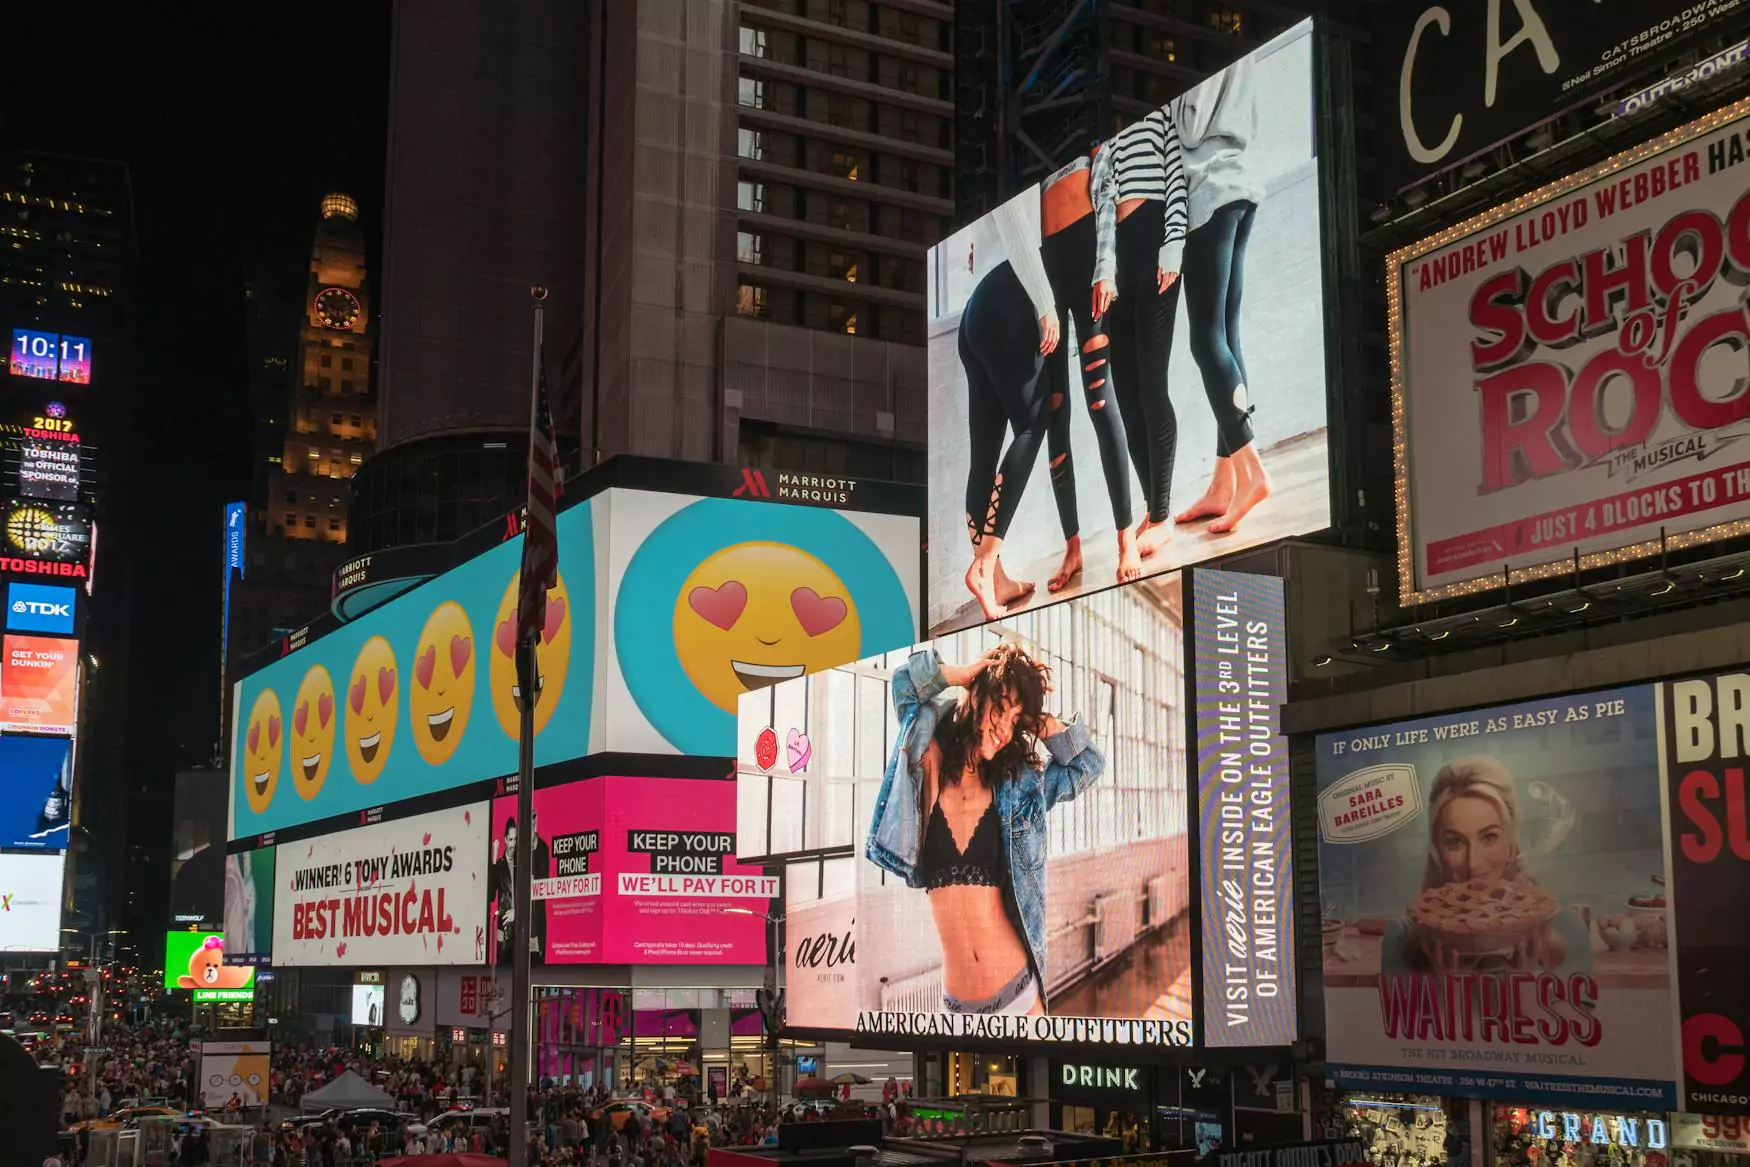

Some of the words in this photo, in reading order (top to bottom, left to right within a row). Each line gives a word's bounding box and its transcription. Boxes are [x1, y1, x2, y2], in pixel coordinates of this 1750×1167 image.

[1601, 0, 1724, 61] CATSBROADWA
[1570, 71, 1591, 88] Neil
[1592, 53, 1627, 76] Simon
[1628, 30, 1674, 57] Theatre
[1682, 13, 1706, 32] 250
[1399, 0, 1560, 164] CA
[1515, 197, 1588, 253] LLOYD
[1594, 151, 1700, 220] WEBBER
[1618, 279, 1699, 369] of
[17, 334, 85, 362] 10:11
[23, 427, 80, 443] TOSHIBA
[33, 416, 73, 432] 2017
[23, 448, 79, 462] TOSHIBA
[35, 460, 77, 473] OFFICIAL
[1614, 449, 1638, 467] THE
[1633, 436, 1708, 474] MUSICAL
[22, 470, 68, 483] SPONSOR
[779, 473, 856, 491] MARRIOTT
[779, 487, 847, 503] MARQUIS
[1530, 510, 1578, 545] JUST
[1584, 508, 1597, 531] 4
[1602, 485, 1683, 527] BLOCKS
[1688, 476, 1716, 506] TO
[231, 531, 239, 568] AWARDS
[0, 557, 87, 577] TOSHIBA
[25, 601, 70, 617] TDK
[1216, 591, 1239, 655] LEVEL
[11, 659, 55, 668] DUNKIN'
[12, 650, 33, 658] GET
[35, 652, 65, 661] YOUR
[1218, 661, 1240, 694] 3RD
[1246, 620, 1271, 757] OUTFITTERS
[1219, 702, 1242, 744] THE
[1332, 741, 1347, 756] IF
[1351, 732, 1391, 754] ONLY
[1395, 728, 1428, 747] LIFE
[1433, 721, 1480, 741] WERE
[1485, 717, 1507, 734] AS
[1512, 709, 1559, 730] EASY
[1564, 706, 1590, 723] AS
[1595, 700, 1625, 717] PIE
[1220, 752, 1243, 784] ON
[1386, 773, 1395, 782] BY
[1250, 764, 1275, 832] EAGLE
[1333, 795, 1404, 827] BAREILLES
[553, 837, 574, 855] KEEP
[574, 833, 597, 852] YOUR
[633, 832, 678, 851] KEEP
[681, 834, 732, 852] YOUR
[1221, 792, 1245, 870] INSIDE
[295, 863, 342, 891] WINNER!
[344, 864, 351, 885] 6
[355, 855, 389, 883] TONY
[391, 845, 453, 879] AWARDS
[559, 856, 587, 875] PHONE
[656, 856, 718, 873] PHONE
[532, 881, 556, 898] WE'LL
[557, 880, 573, 896] PAY
[573, 878, 590, 894] FOR
[591, 877, 600, 892] IT
[622, 876, 678, 893] WE'LL
[683, 877, 718, 894] PAY
[720, 878, 756, 895] FOR
[761, 879, 777, 895] IT
[1252, 841, 1277, 962] AMERICAN
[293, 898, 341, 940] BEST
[343, 888, 453, 937] MUSICAL
[1217, 880, 1247, 959] aerie
[795, 918, 855, 969] aeri
[1226, 963, 1249, 1027] VISIT
[1255, 968, 1278, 998] OF
[1376, 971, 1602, 1047] WAITRESS
[855, 1011, 955, 1036] AMERICAN
[962, 1014, 1029, 1040] EAGLE
[1035, 1016, 1192, 1047] OUTFITTERS
[1400, 1047, 1425, 1059] THE
[1427, 1049, 1448, 1060] HIT
[1451, 1049, 1519, 1064] BROADWAY
[1525, 1051, 1587, 1066] MUSICAL
[1062, 1063, 1140, 1091] DRINK
[1340, 1070, 1370, 1080] BROOKS
[1372, 1072, 1414, 1082] ATKINSON
[1415, 1074, 1453, 1084] THEATRE
[1524, 1080, 1664, 1098] WAITRESSTHEMUSICAL.COM
[1537, 1111, 1667, 1149] GRAND
